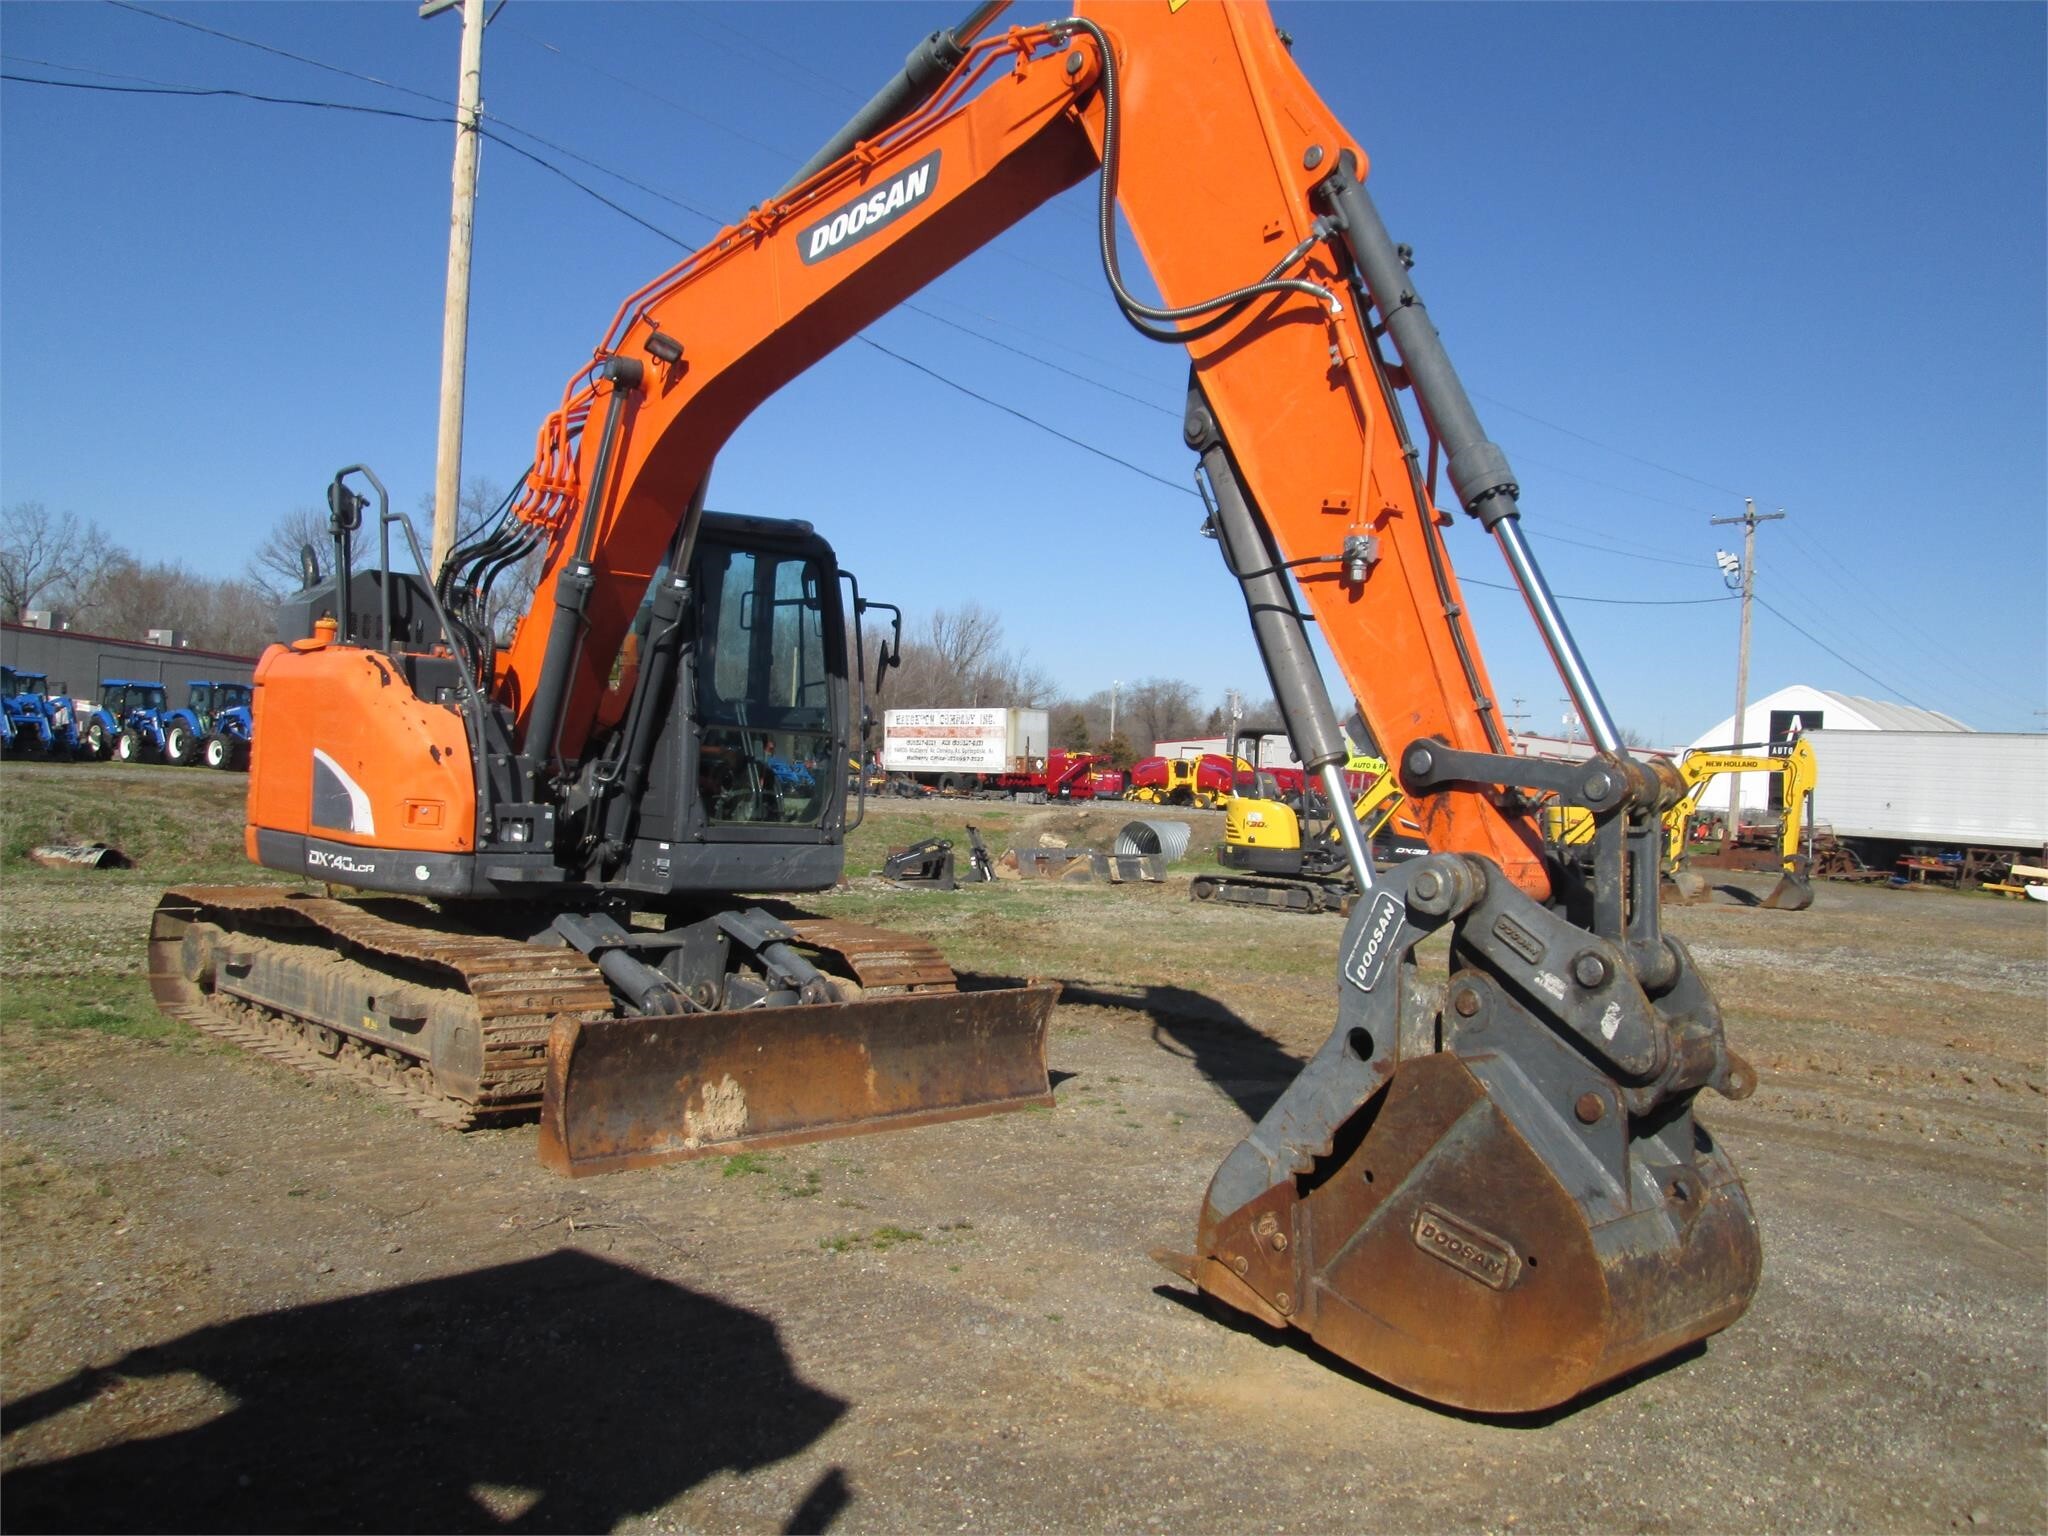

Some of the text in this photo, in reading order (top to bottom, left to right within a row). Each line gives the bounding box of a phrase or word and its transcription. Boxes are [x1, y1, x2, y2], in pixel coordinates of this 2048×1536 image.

[809, 163, 930, 259] DOOSAN
[1705, 760, 1758, 768] NEW HOLLAND
[1772, 746, 1794, 755] AUTO
[1357, 902, 1395, 981] DOOSAN
[1421, 1223, 1502, 1274] DOOSAN
